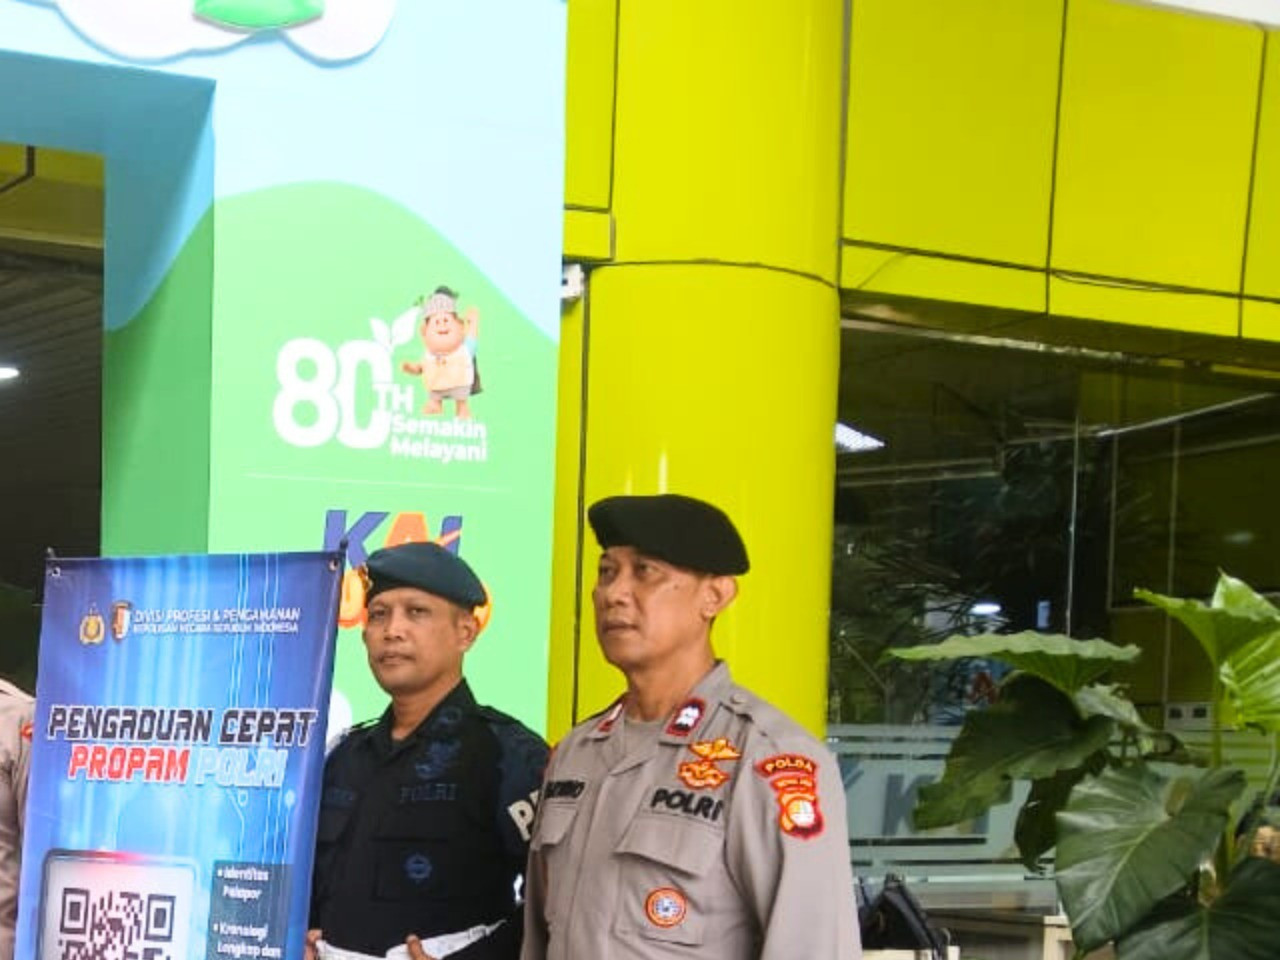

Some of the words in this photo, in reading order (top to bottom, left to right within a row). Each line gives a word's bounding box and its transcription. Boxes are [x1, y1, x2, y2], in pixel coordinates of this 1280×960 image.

[391, 414, 487, 438] Semakin
[391, 435, 487, 464] Melayani
[47, 706, 213, 743] PENGADUAN
[219, 707, 318, 745] CEPAT
[67, 746, 190, 783] PROPAM
[195, 748, 288, 787] POLRI
[765, 757, 813, 774] POLDA
[650, 789, 723, 822] POLRI
